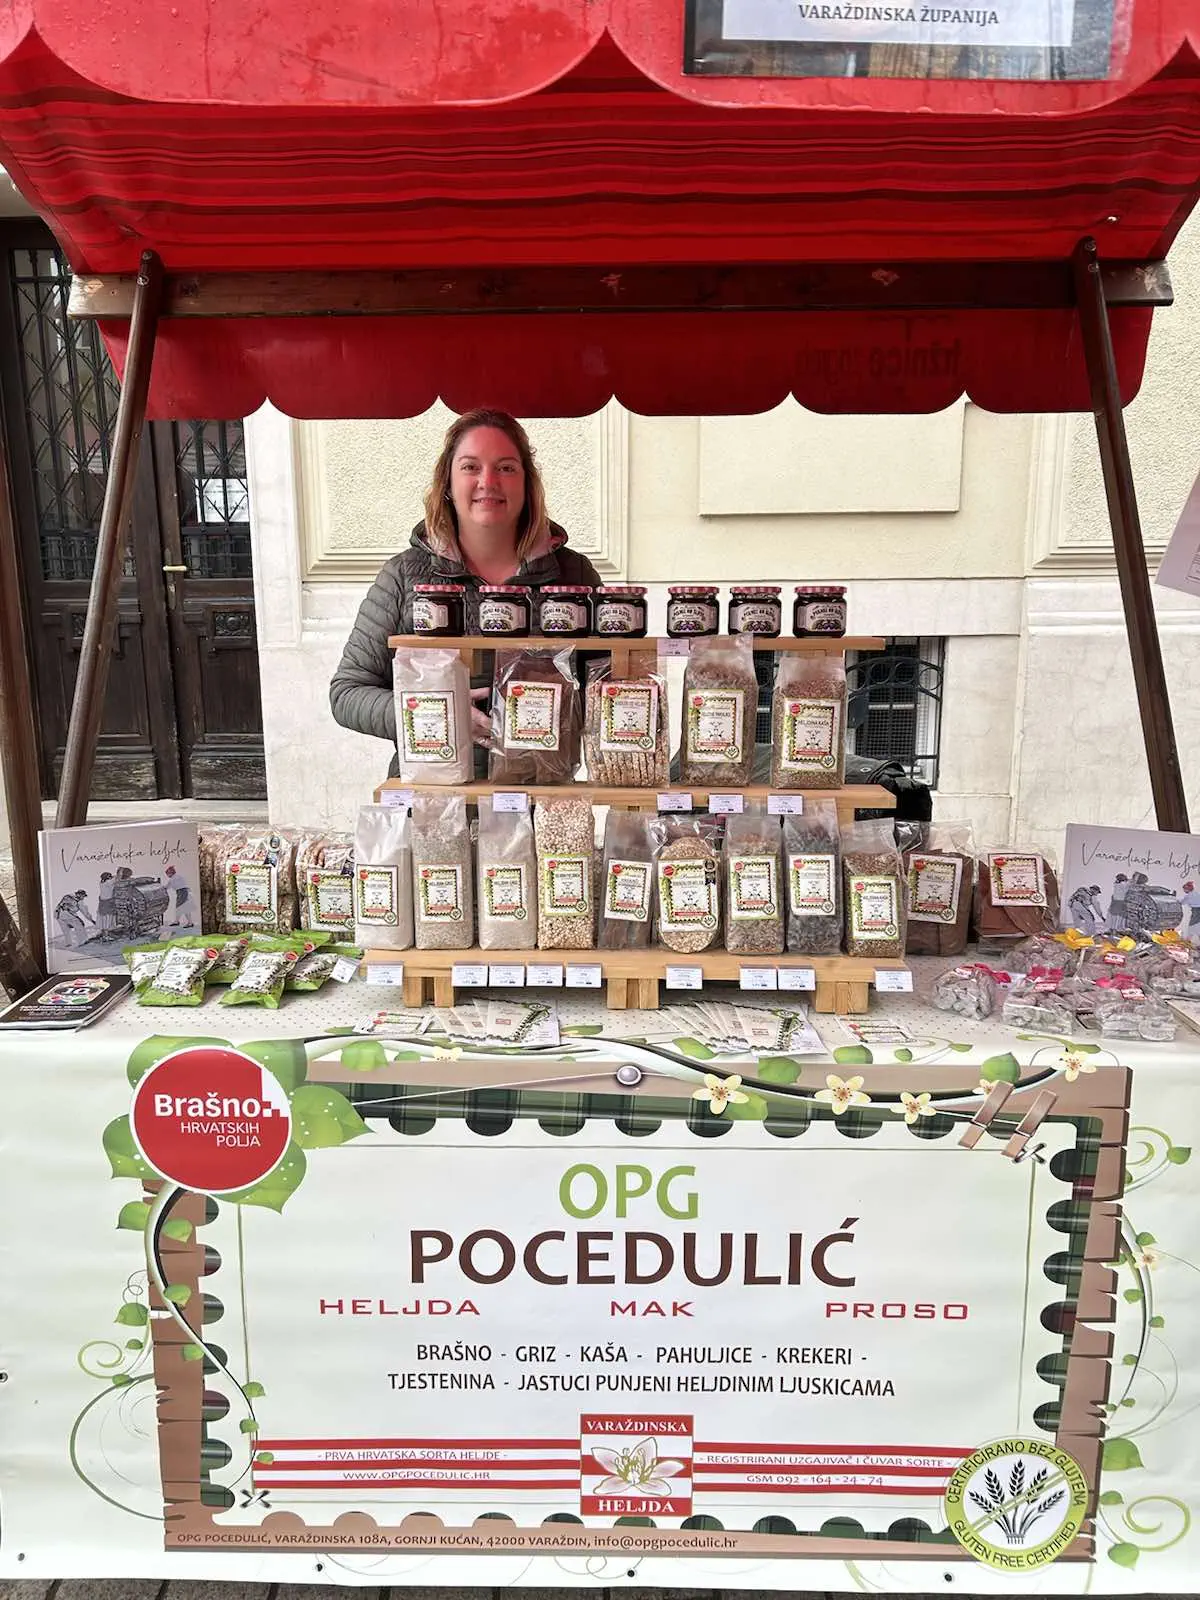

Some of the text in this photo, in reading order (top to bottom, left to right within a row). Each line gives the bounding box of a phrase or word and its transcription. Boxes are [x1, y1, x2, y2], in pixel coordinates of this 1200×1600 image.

[799, 4, 999, 26] VARAŽDINSKA ŽUPANIJA
[61, 839, 187, 873] Varaždinska heljda
[1082, 840, 1162, 869] Varaždinska
[154, 1093, 261, 1118] Brašno
[181, 1121, 260, 1135] HRVATSKIH
[216, 1135, 261, 1148] POLJA
[558, 1163, 699, 1220] OPG
[411, 1217, 860, 1287] POCEDULIĆ
[319, 1298, 480, 1316] HELJDA
[610, 1301, 694, 1317] MAK
[825, 1302, 968, 1320] PROSO
[416, 1340, 492, 1362] BRAŠNO
[515, 1345, 556, 1363] GRIZ
[580, 1341, 628, 1363] KAŠA
[656, 1346, 752, 1364] PAHULJICE
[777, 1347, 852, 1365] KREKERI
[387, 1373, 495, 1390] TJESTENINA
[518, 1374, 590, 1391] JASTUCI
[596, 1375, 671, 1392] PUNJENI
[677, 1376, 774, 1393] HELJDINIM
[780, 1376, 896, 1397] LJUSKICAMA
[586, 1418, 688, 1432] VARAŽDINSKA
[325, 1451, 354, 1461] PRVA
[357, 1450, 416, 1460] HRVATSKA
[420, 1451, 457, 1460] SORTA
[460, 1451, 500, 1461] HELJDE
[707, 1455, 785, 1465] REGISTRIRANI
[789, 1454, 852, 1465] UZGAJIVAČ
[863, 1454, 902, 1466] ČUVAR
[906, 1458, 943, 1467] SORTE
[343, 1470, 490, 1480] WWW.OPGPOCEDULIC.HR
[747, 1475, 773, 1483] GSM
[776, 1476, 800, 1485] 092
[811, 1474, 832, 1486] 164
[843, 1476, 857, 1486] 24
[868, 1476, 883, 1486] 74
[947, 1441, 1086, 1506] CERTIFICIRANO BEZ GLUTENA
[598, 1499, 675, 1513] HELJDA
[177, 1531, 738, 1550] OPG POCEDULIĆ, VARAŽDINSKA 108A, GORNJI KUĆAN, 42000 VARAŽDIN, info@opgpocedulic.hr
[954, 1520, 1077, 1568] GLUTEN FREE CERTIFIED
